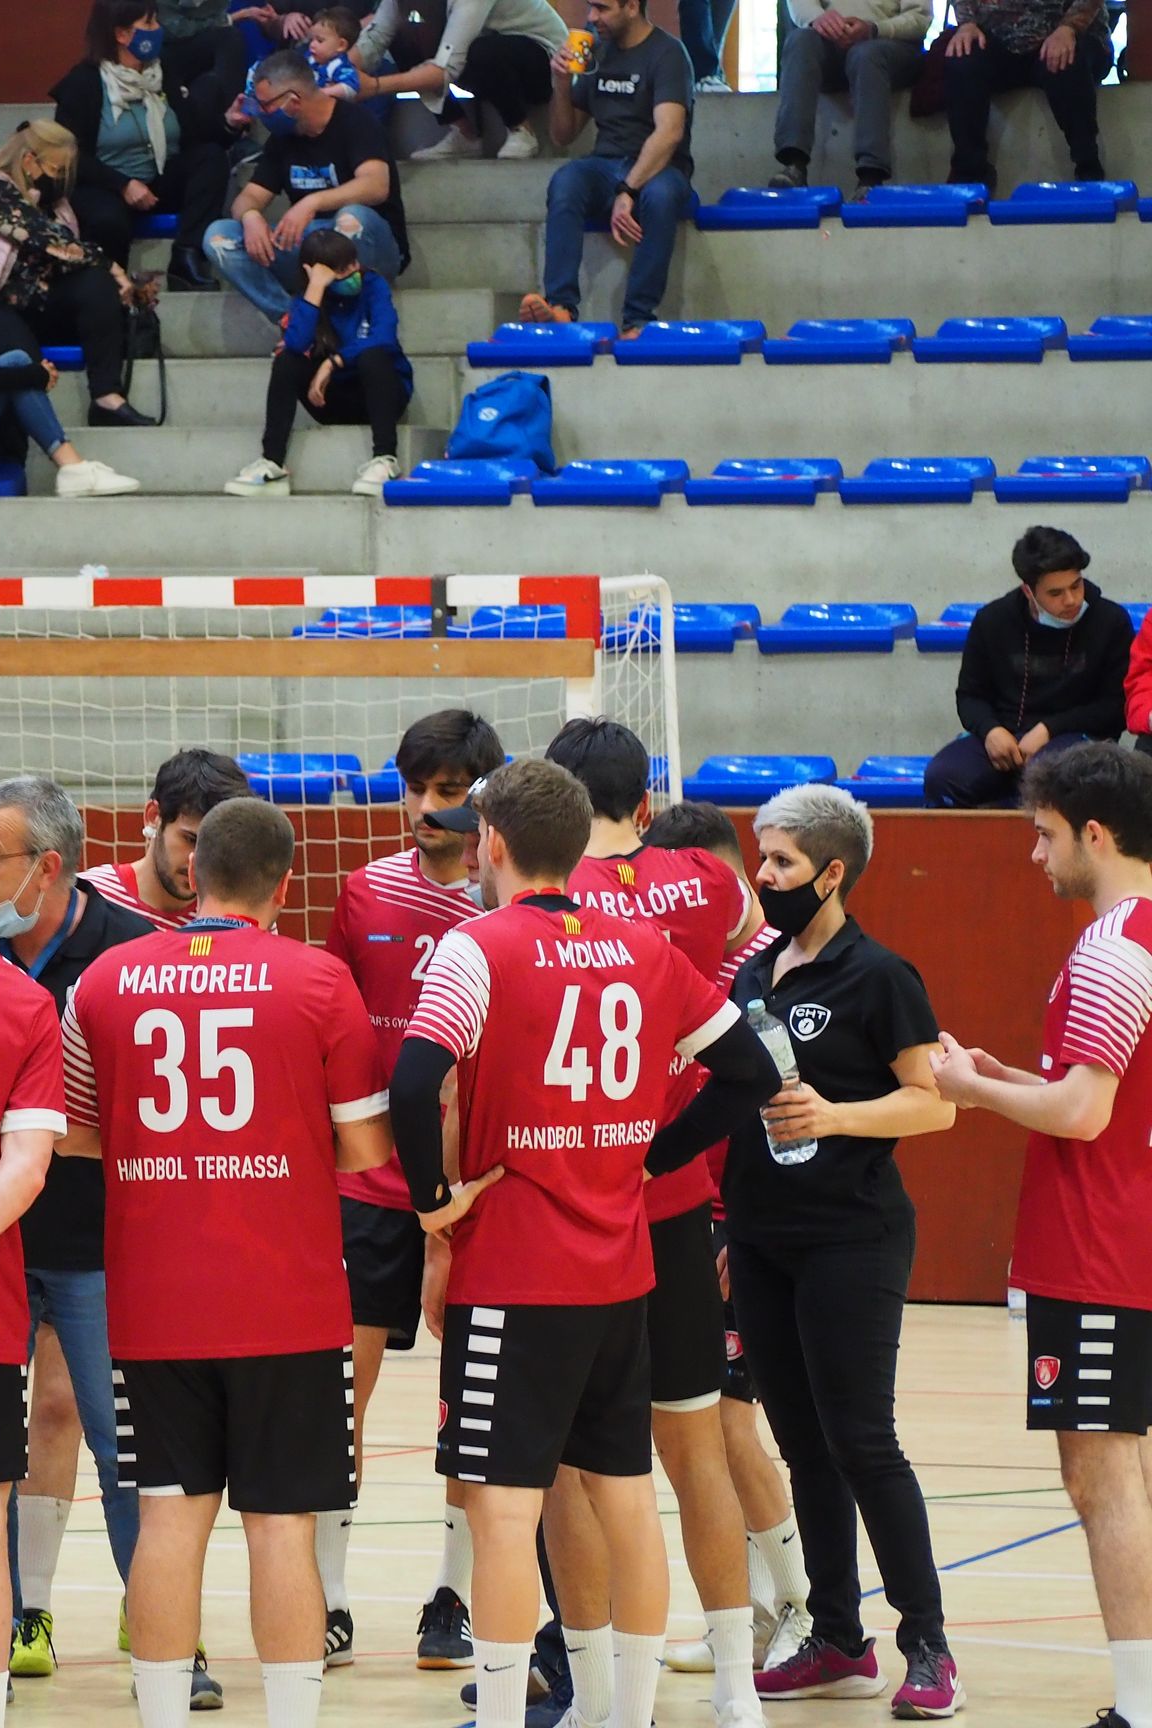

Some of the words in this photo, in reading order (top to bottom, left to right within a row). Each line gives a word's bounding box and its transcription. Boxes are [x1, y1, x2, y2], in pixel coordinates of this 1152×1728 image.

[634, 877, 709, 918] LÓPEZ
[535, 938, 554, 968] J.
[555, 938, 636, 969] MOLINA
[118, 962, 274, 996] MARTORELL
[795, 1008, 827, 1020] CHT
[543, 981, 644, 1103] 48
[133, 1007, 256, 1133] 35
[507, 1125, 586, 1150] HANDBOL
[593, 1118, 656, 1148] TERRASSA
[194, 1154, 291, 1180] TERRASSA
